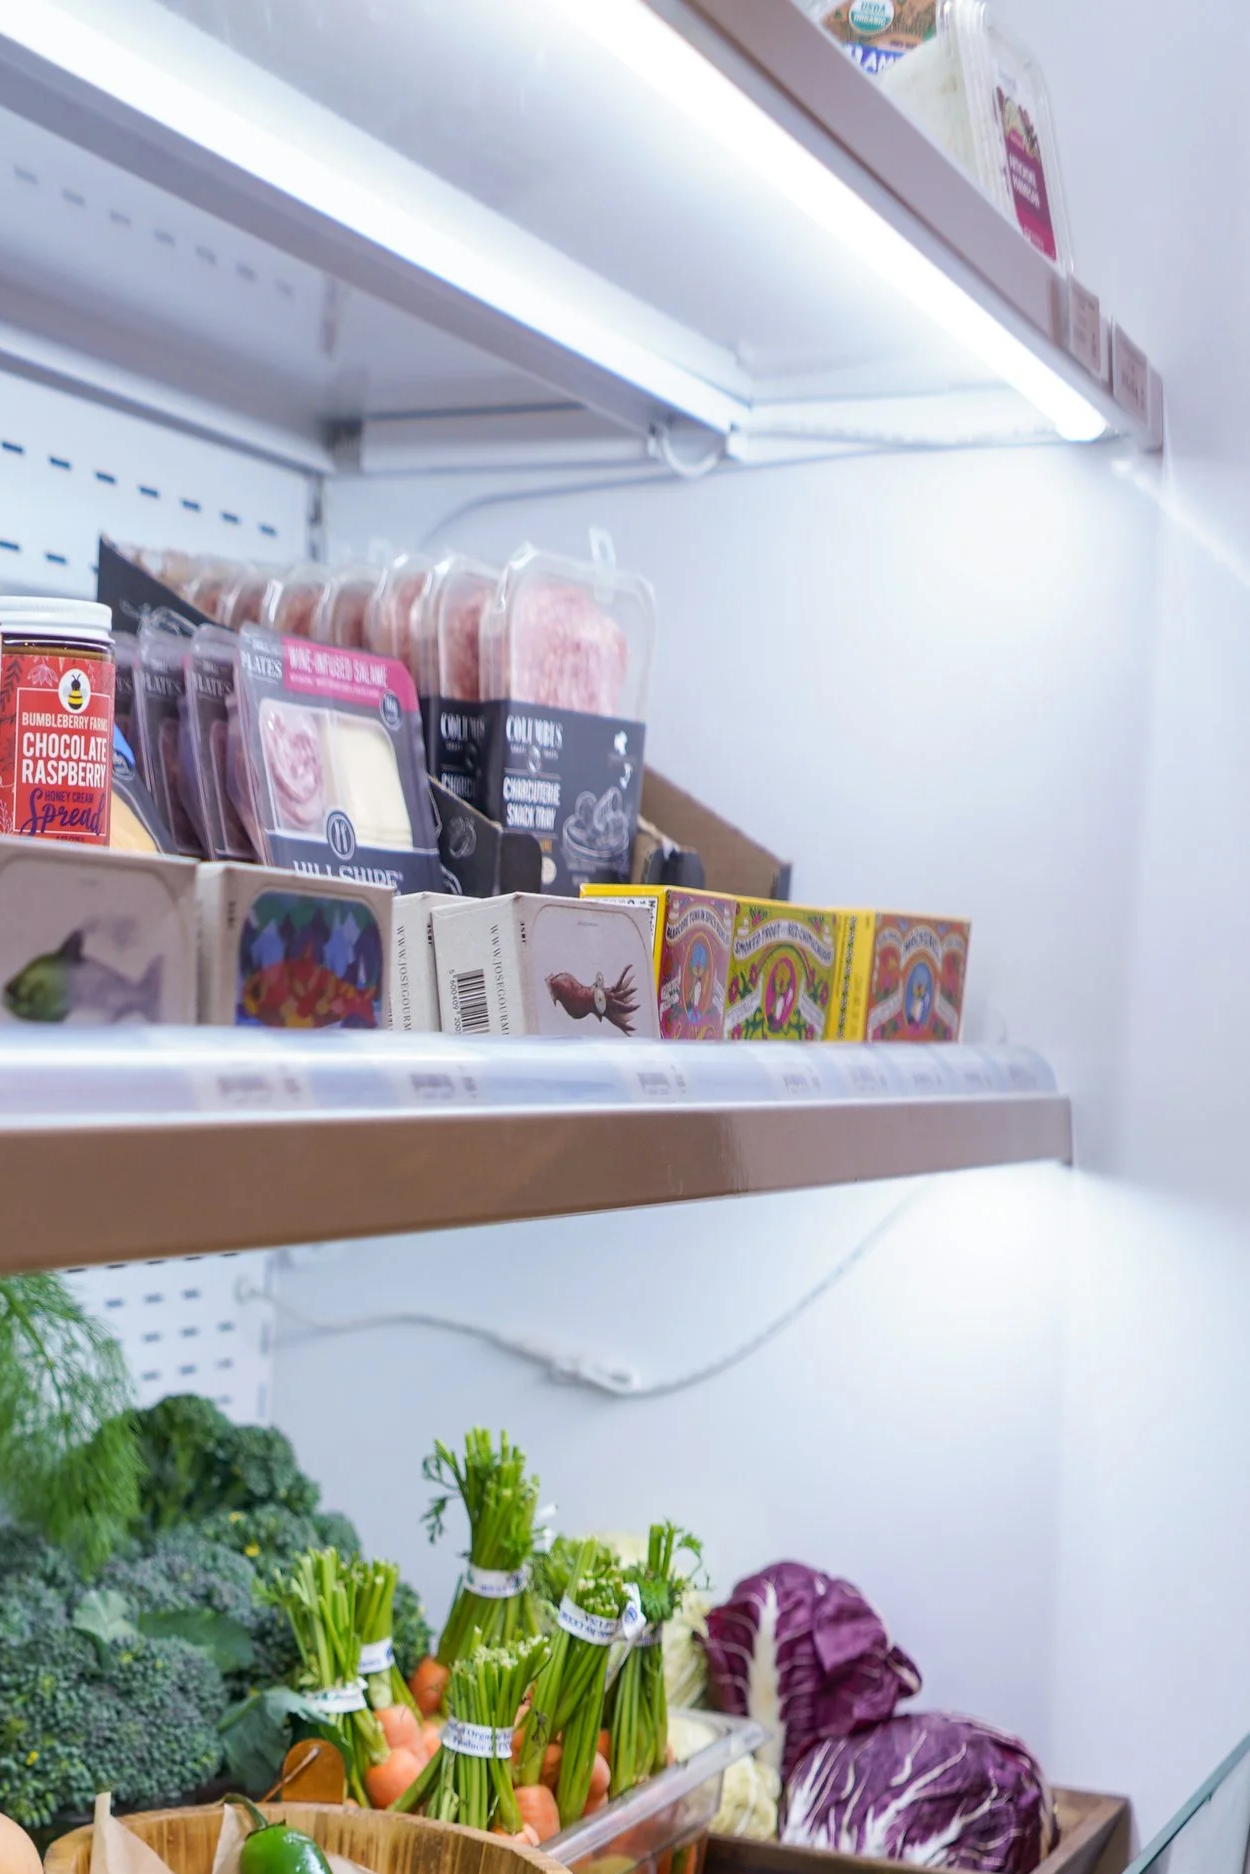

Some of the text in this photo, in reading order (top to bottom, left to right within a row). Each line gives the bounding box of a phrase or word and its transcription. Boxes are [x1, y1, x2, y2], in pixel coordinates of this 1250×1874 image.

[240, 649, 283, 679] PLATES
[22, 712, 89, 730] BUMBLEBERRY
[505, 715, 564, 750] COLUMBUS
[22, 732, 107, 762] CHOCOLATE
[21, 759, 106, 789] RASPBERRY
[45, 790, 94, 804] HONEY CREAM
[503, 776, 561, 806] CHARCUTERIE
[19, 787, 105, 836] Spread
[507, 803, 535, 828] SNACK
